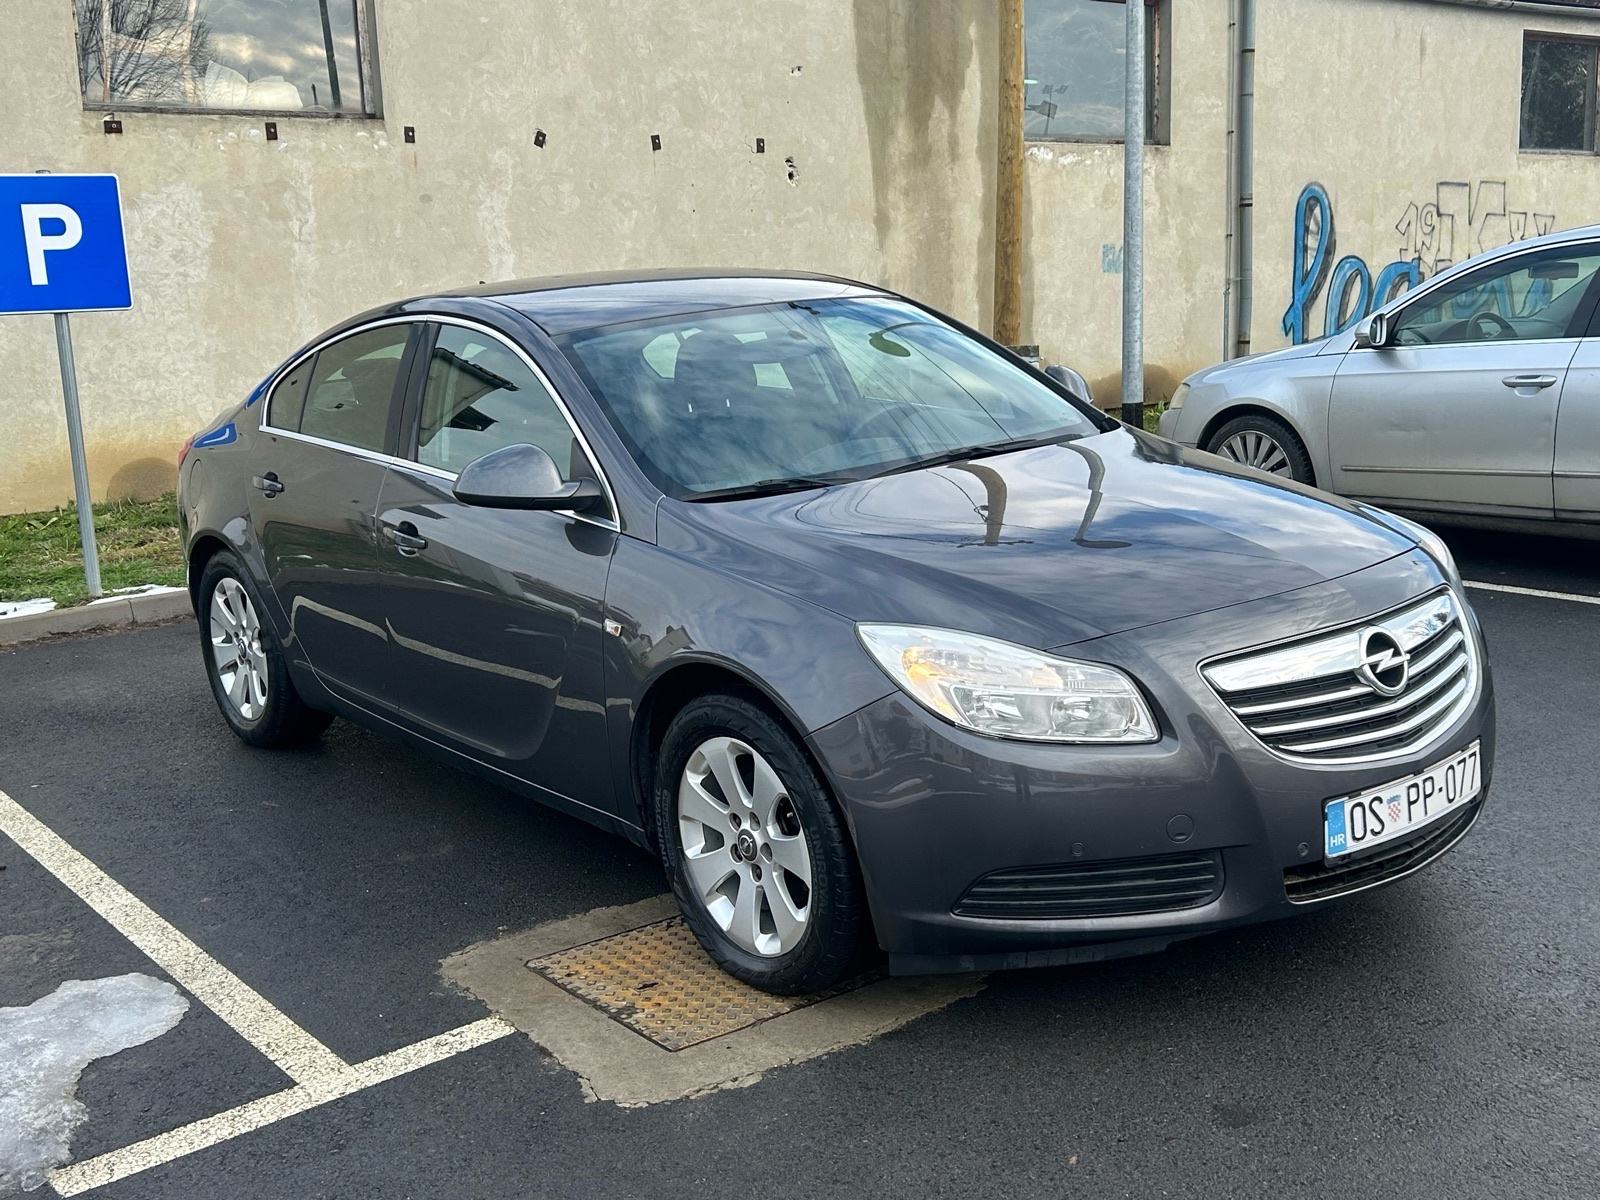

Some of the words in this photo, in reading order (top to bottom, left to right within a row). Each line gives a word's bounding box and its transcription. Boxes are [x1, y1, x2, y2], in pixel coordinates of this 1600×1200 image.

[21, 203, 82, 286] P
[1350, 796, 1386, 842] OS
[1407, 751, 1478, 824] PP-077
[1330, 833, 1345, 848] HR
